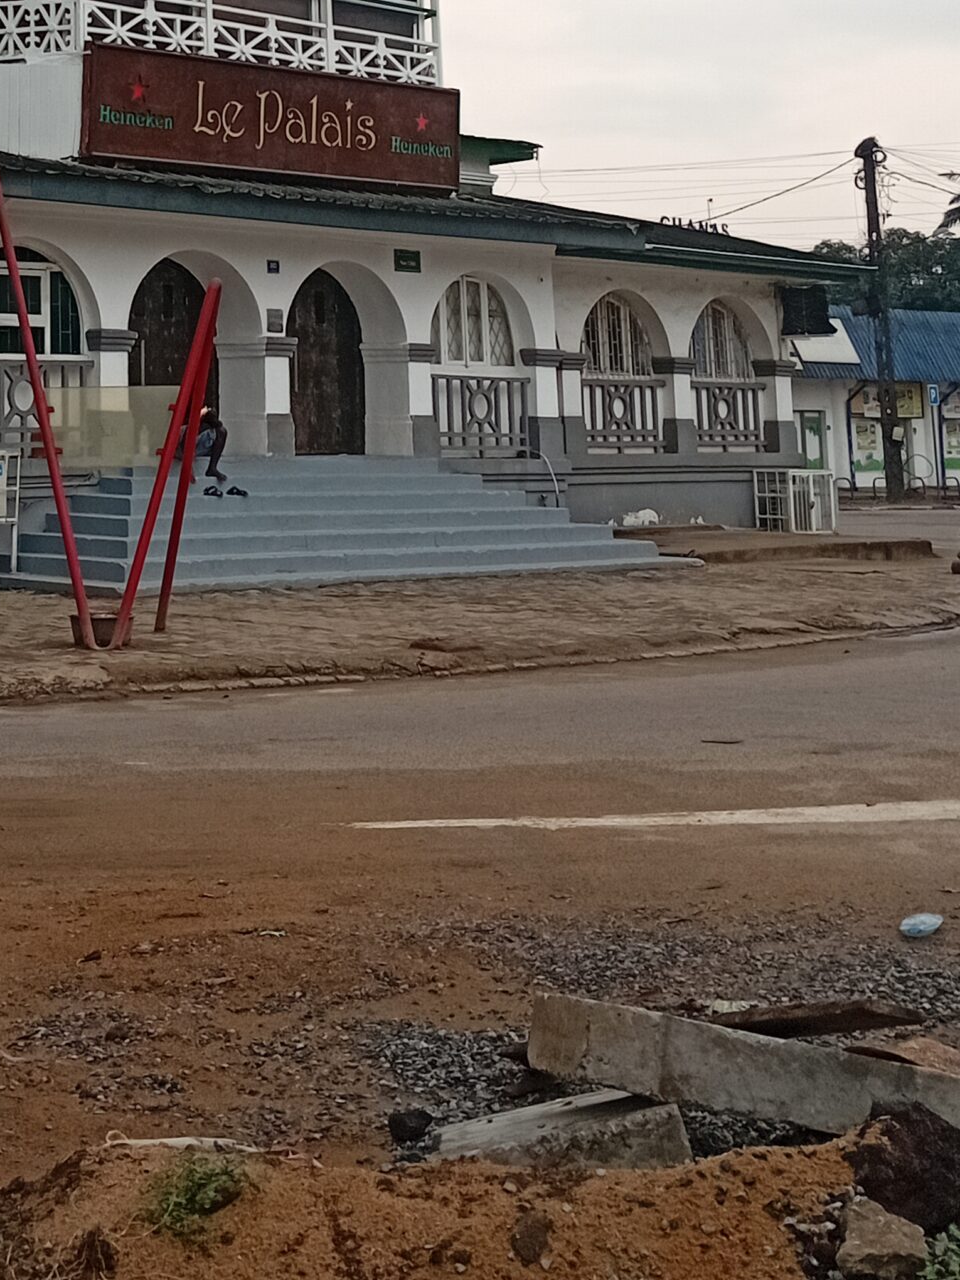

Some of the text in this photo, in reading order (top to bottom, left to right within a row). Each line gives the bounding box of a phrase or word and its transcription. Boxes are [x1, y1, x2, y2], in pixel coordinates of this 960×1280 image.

[99, 105, 173, 130] Heineken
[193, 80, 377, 151] Le Palais
[391, 136, 451, 158] Heineken
[930, 388, 936, 402] P
